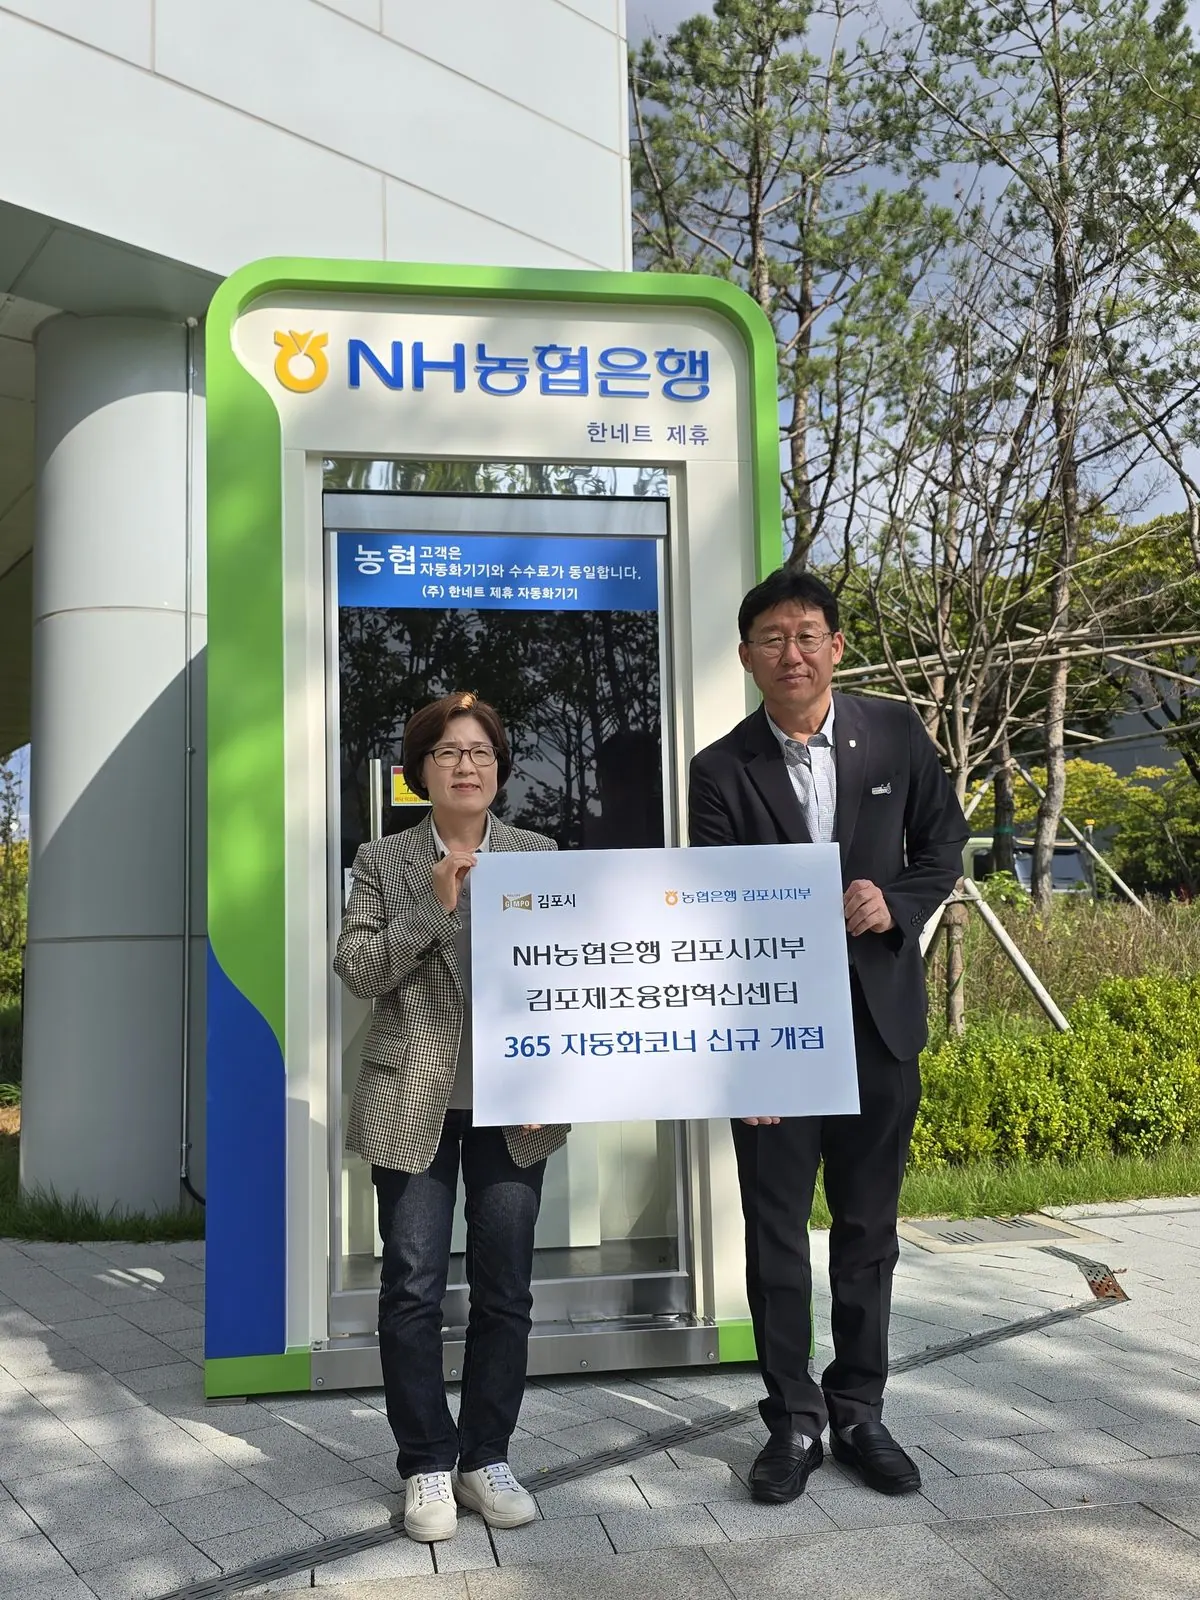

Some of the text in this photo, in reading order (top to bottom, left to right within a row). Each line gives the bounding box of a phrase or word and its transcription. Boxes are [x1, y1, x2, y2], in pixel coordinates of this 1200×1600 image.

[347, 338, 711, 402] NH농협은행
[586, 422, 710, 446] 한네트 제휴
[354, 544, 415, 576] 농협
[419, 546, 462, 560] 고객은
[420, 563, 641, 580] 자동화기기와 수수료가 동일합니다.
[422, 586, 578, 600] (주) 한네트 제휴 자동화기기
[504, 900, 530, 908] GIMPO
[537, 893, 576, 909] 김포시
[682, 887, 812, 904] 농협은행 김포시지부
[512, 937, 806, 967] NH농협은행 김포시지부
[526, 981, 799, 1012] 김포제조융합혁신센터
[504, 1026, 825, 1058] 365 자동화코너 신규 개점
